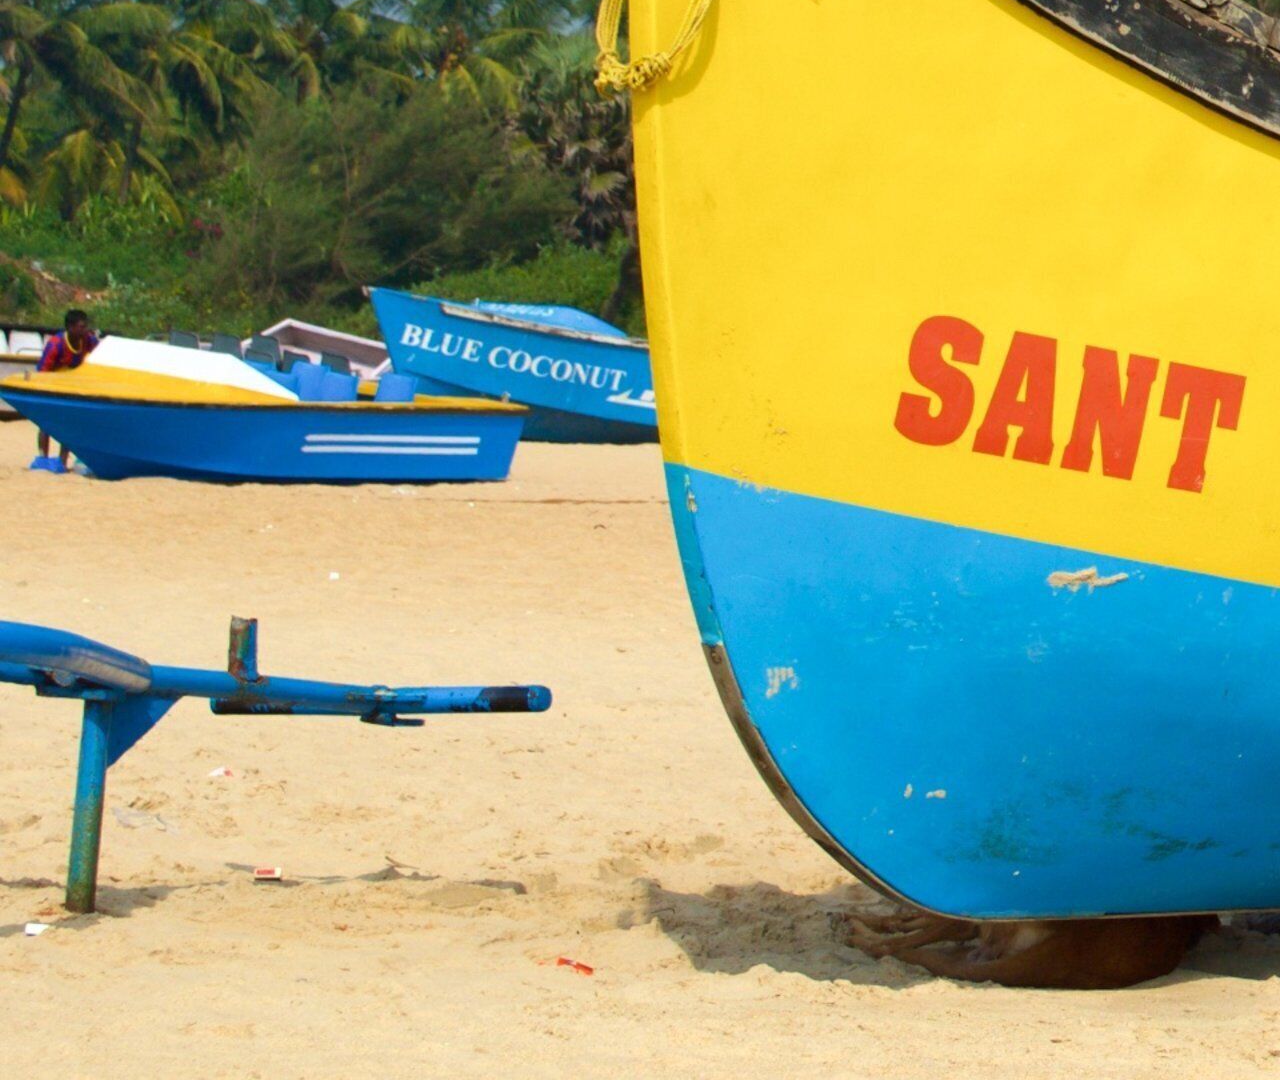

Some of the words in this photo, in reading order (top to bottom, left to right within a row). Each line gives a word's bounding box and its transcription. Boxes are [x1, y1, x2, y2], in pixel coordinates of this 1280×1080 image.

[400, 323, 483, 363] BLUE
[488, 345, 628, 392] COCONUT
[894, 316, 1246, 493] SANT
